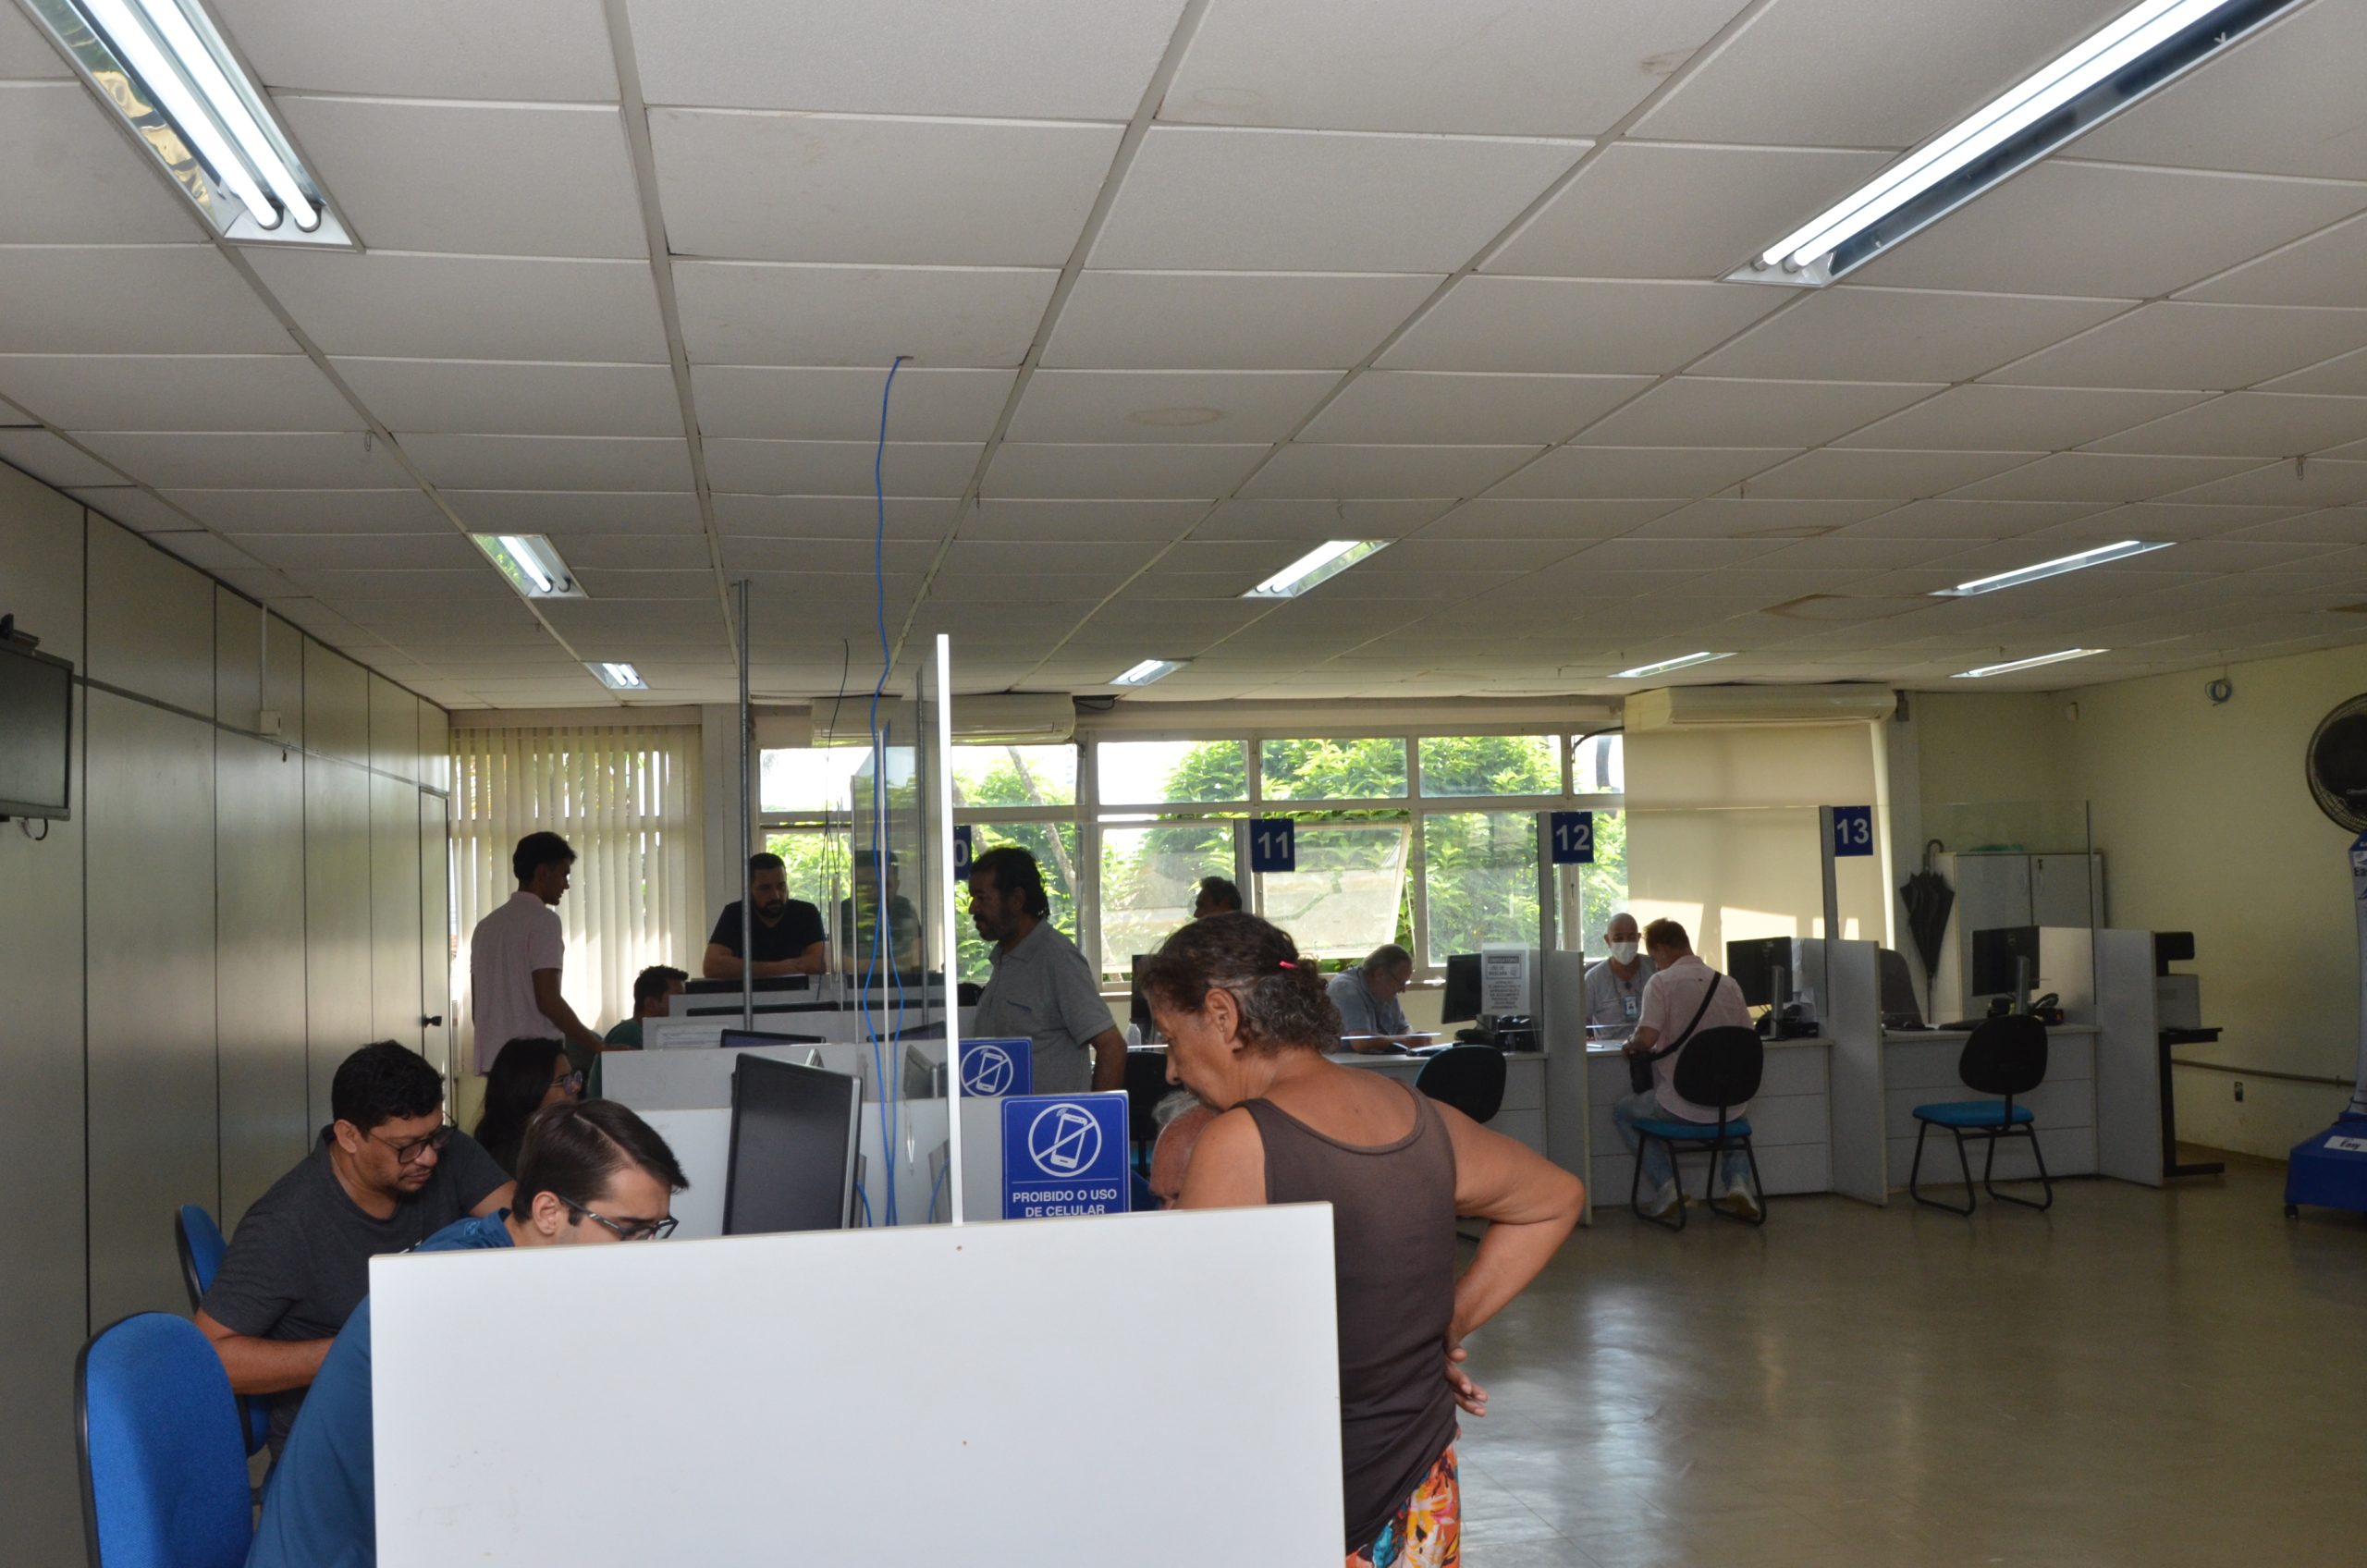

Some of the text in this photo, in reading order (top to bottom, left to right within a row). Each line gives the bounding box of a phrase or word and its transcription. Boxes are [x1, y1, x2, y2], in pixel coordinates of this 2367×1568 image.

[1556, 825, 1590, 851] 12
[1836, 818, 1870, 845] 13
[954, 839, 968, 867] 0
[1258, 832, 1289, 859] 11
[2353, 866, 2367, 876] Ea
[1012, 1189, 1117, 1203] PROIBIDO O USO
[1025, 1205, 1105, 1218] DE CELULAR
